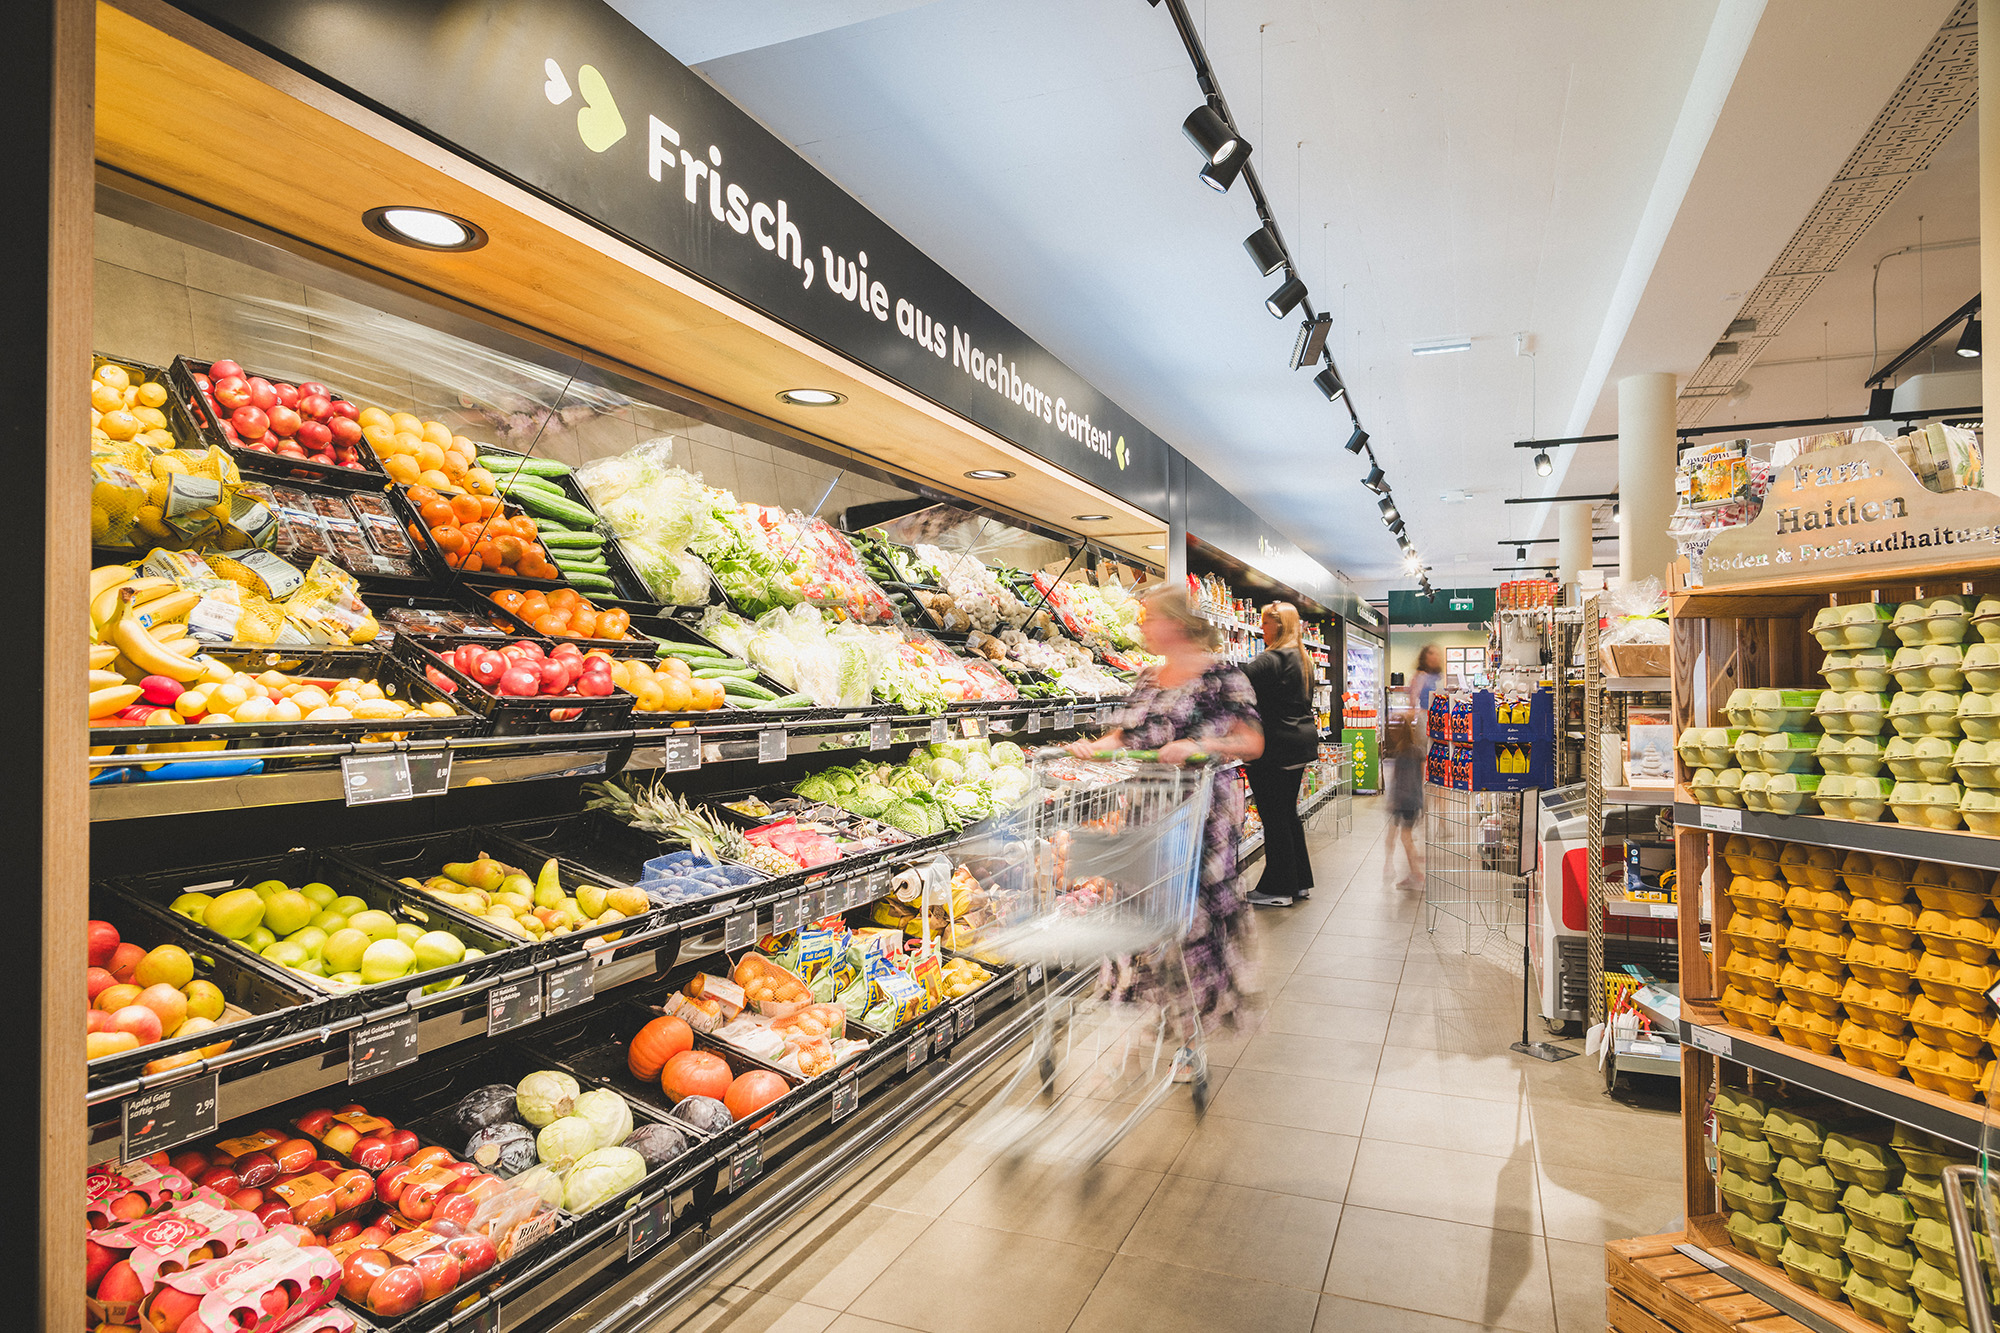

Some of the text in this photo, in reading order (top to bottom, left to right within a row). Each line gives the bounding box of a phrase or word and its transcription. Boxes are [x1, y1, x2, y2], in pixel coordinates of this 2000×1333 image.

[649, 114, 1112, 460] Frisch, wie aus Nachbars Garten!
[1792, 459, 1884, 493] Fam.
[1774, 494, 1909, 536] Haiden
[1707, 551, 1770, 573] Boden
[1775, 548, 1793, 564] &
[129, 1091, 172, 1110] Apfel Gala
[129, 1099, 171, 1119] saftig-süß
[519, 1221, 540, 1240] BIO
